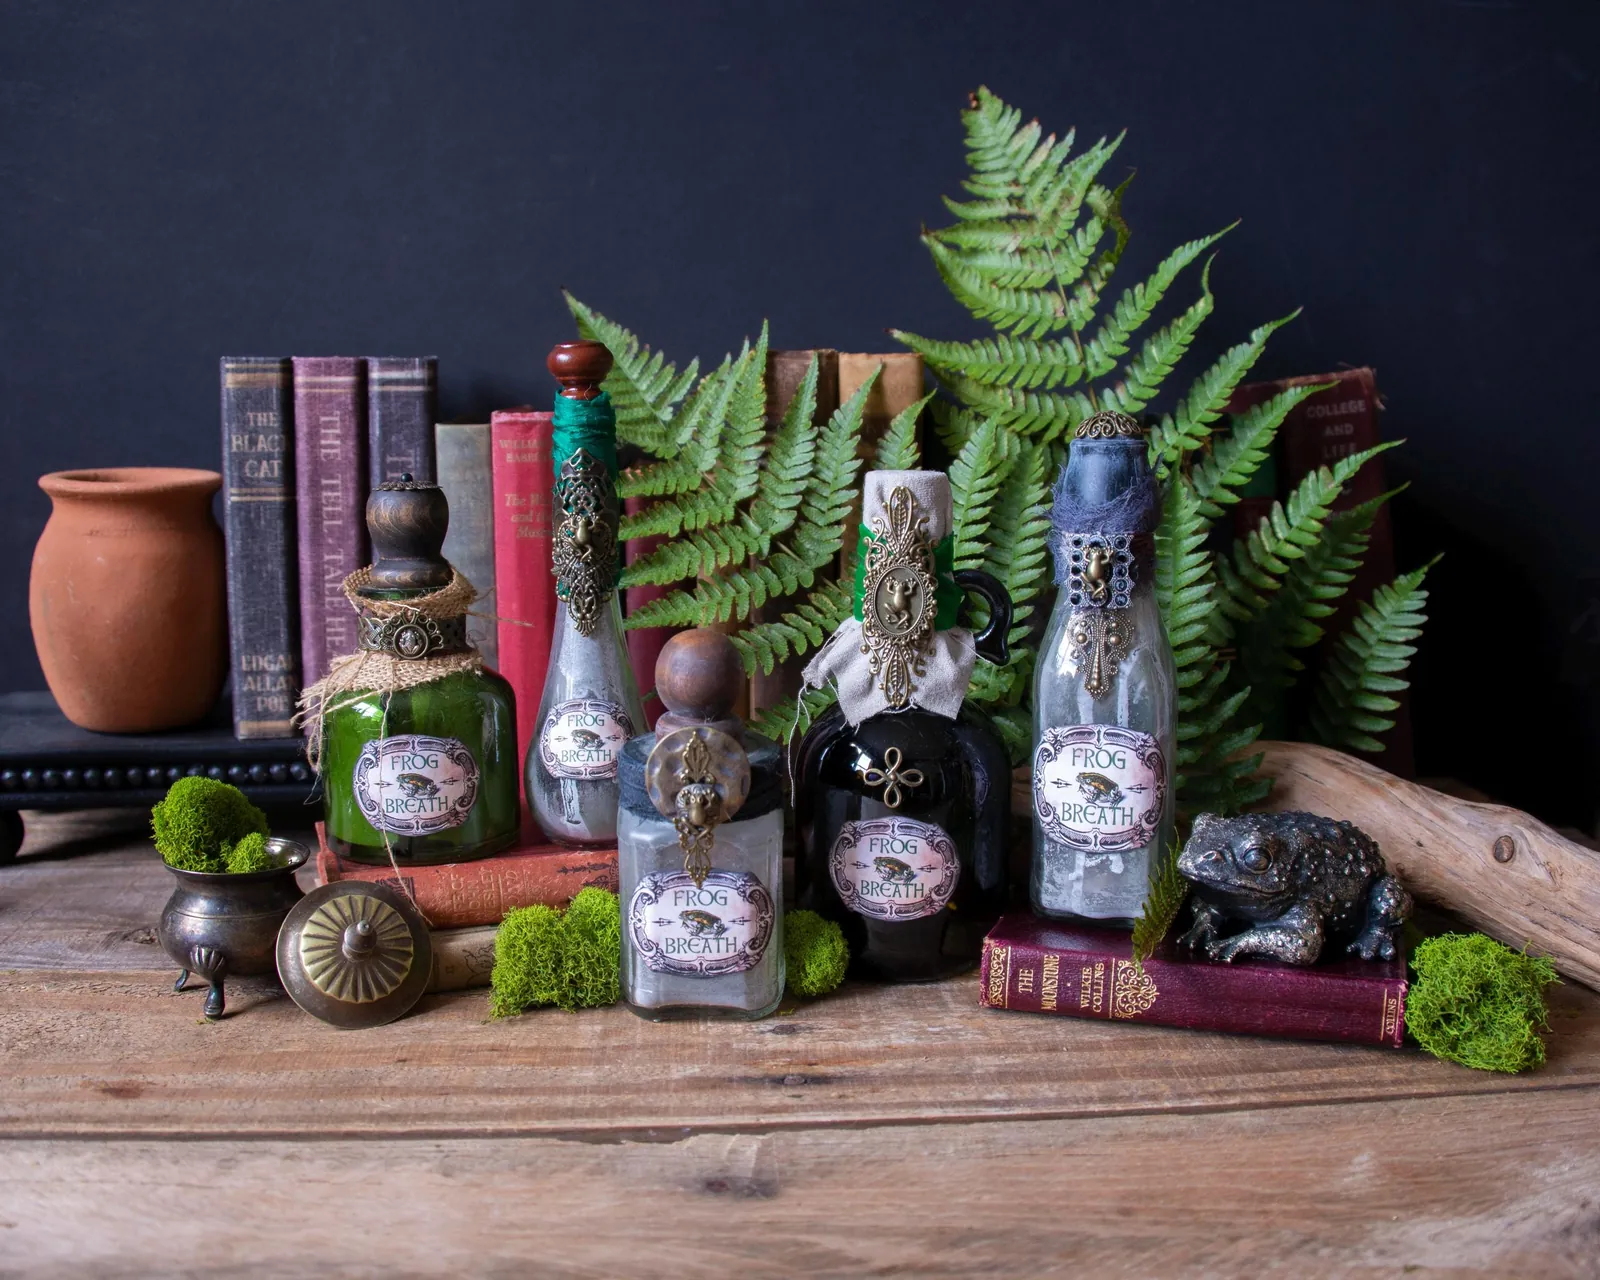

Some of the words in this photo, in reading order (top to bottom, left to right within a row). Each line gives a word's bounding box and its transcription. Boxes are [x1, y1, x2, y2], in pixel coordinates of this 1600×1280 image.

[1306, 399, 1366, 418] COLLEGE
[247, 412, 279, 427] THE
[319, 410, 341, 462] THE
[1323, 423, 1354, 437] AND
[244, 459, 283, 478] CAT
[257, 695, 290, 712] POE
[567, 714, 605, 727] FROG
[390, 753, 439, 771] FROG
[561, 749, 612, 763] BREATH
[1071, 747, 1126, 770] FROG
[385, 795, 449, 814] BREATH
[1061, 802, 1134, 826] BREATH
[869, 837, 918, 855] FROG
[673, 889, 728, 906] FROG
[860, 880, 924, 898] BREATH
[665, 936, 737, 954] BREATH
[1018, 968, 1034, 994] THE
[1041, 954, 1060, 1011] MOONSTONE
[1080, 966, 1092, 1009] WILKIE
[1092, 962, 1105, 1013] COLLINS
[1385, 998, 1397, 1035] COLLINS
